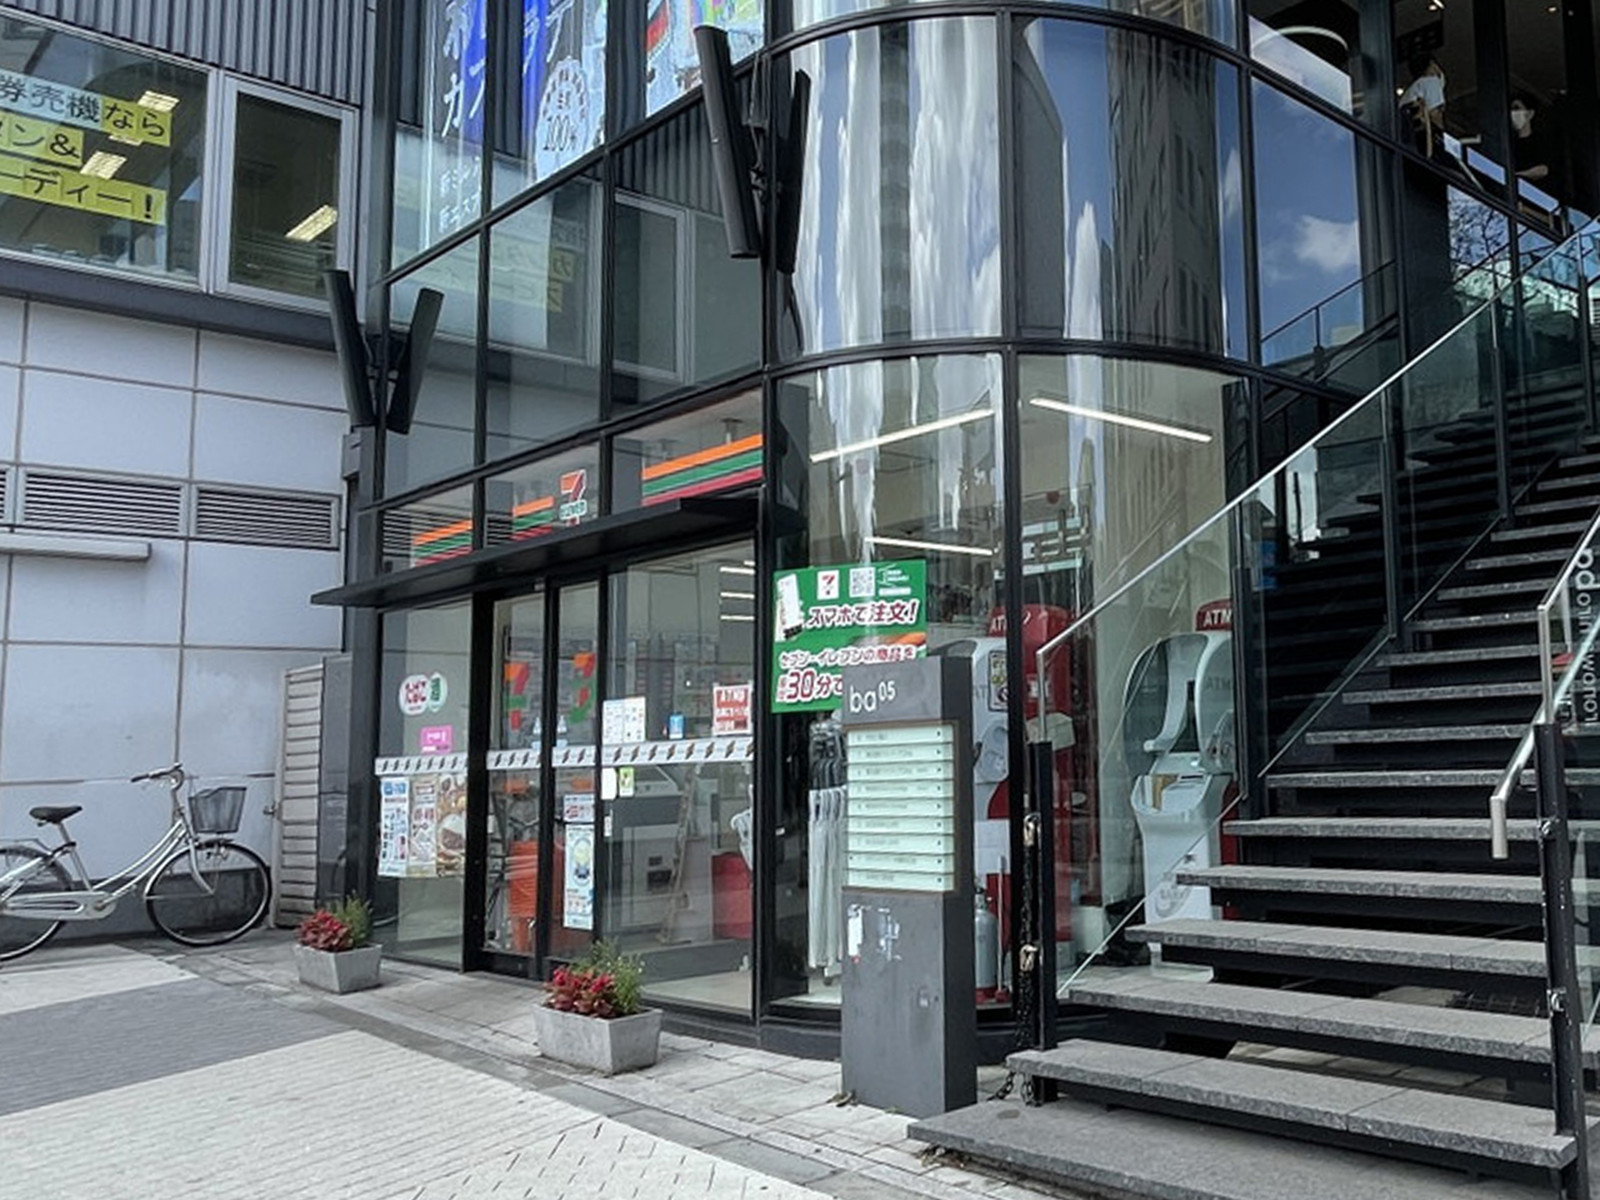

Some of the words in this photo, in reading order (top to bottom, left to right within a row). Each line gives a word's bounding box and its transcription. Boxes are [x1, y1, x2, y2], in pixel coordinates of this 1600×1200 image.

[0, 121, 80, 159] ン&
[808, 601, 918, 627] スマホで注文!
